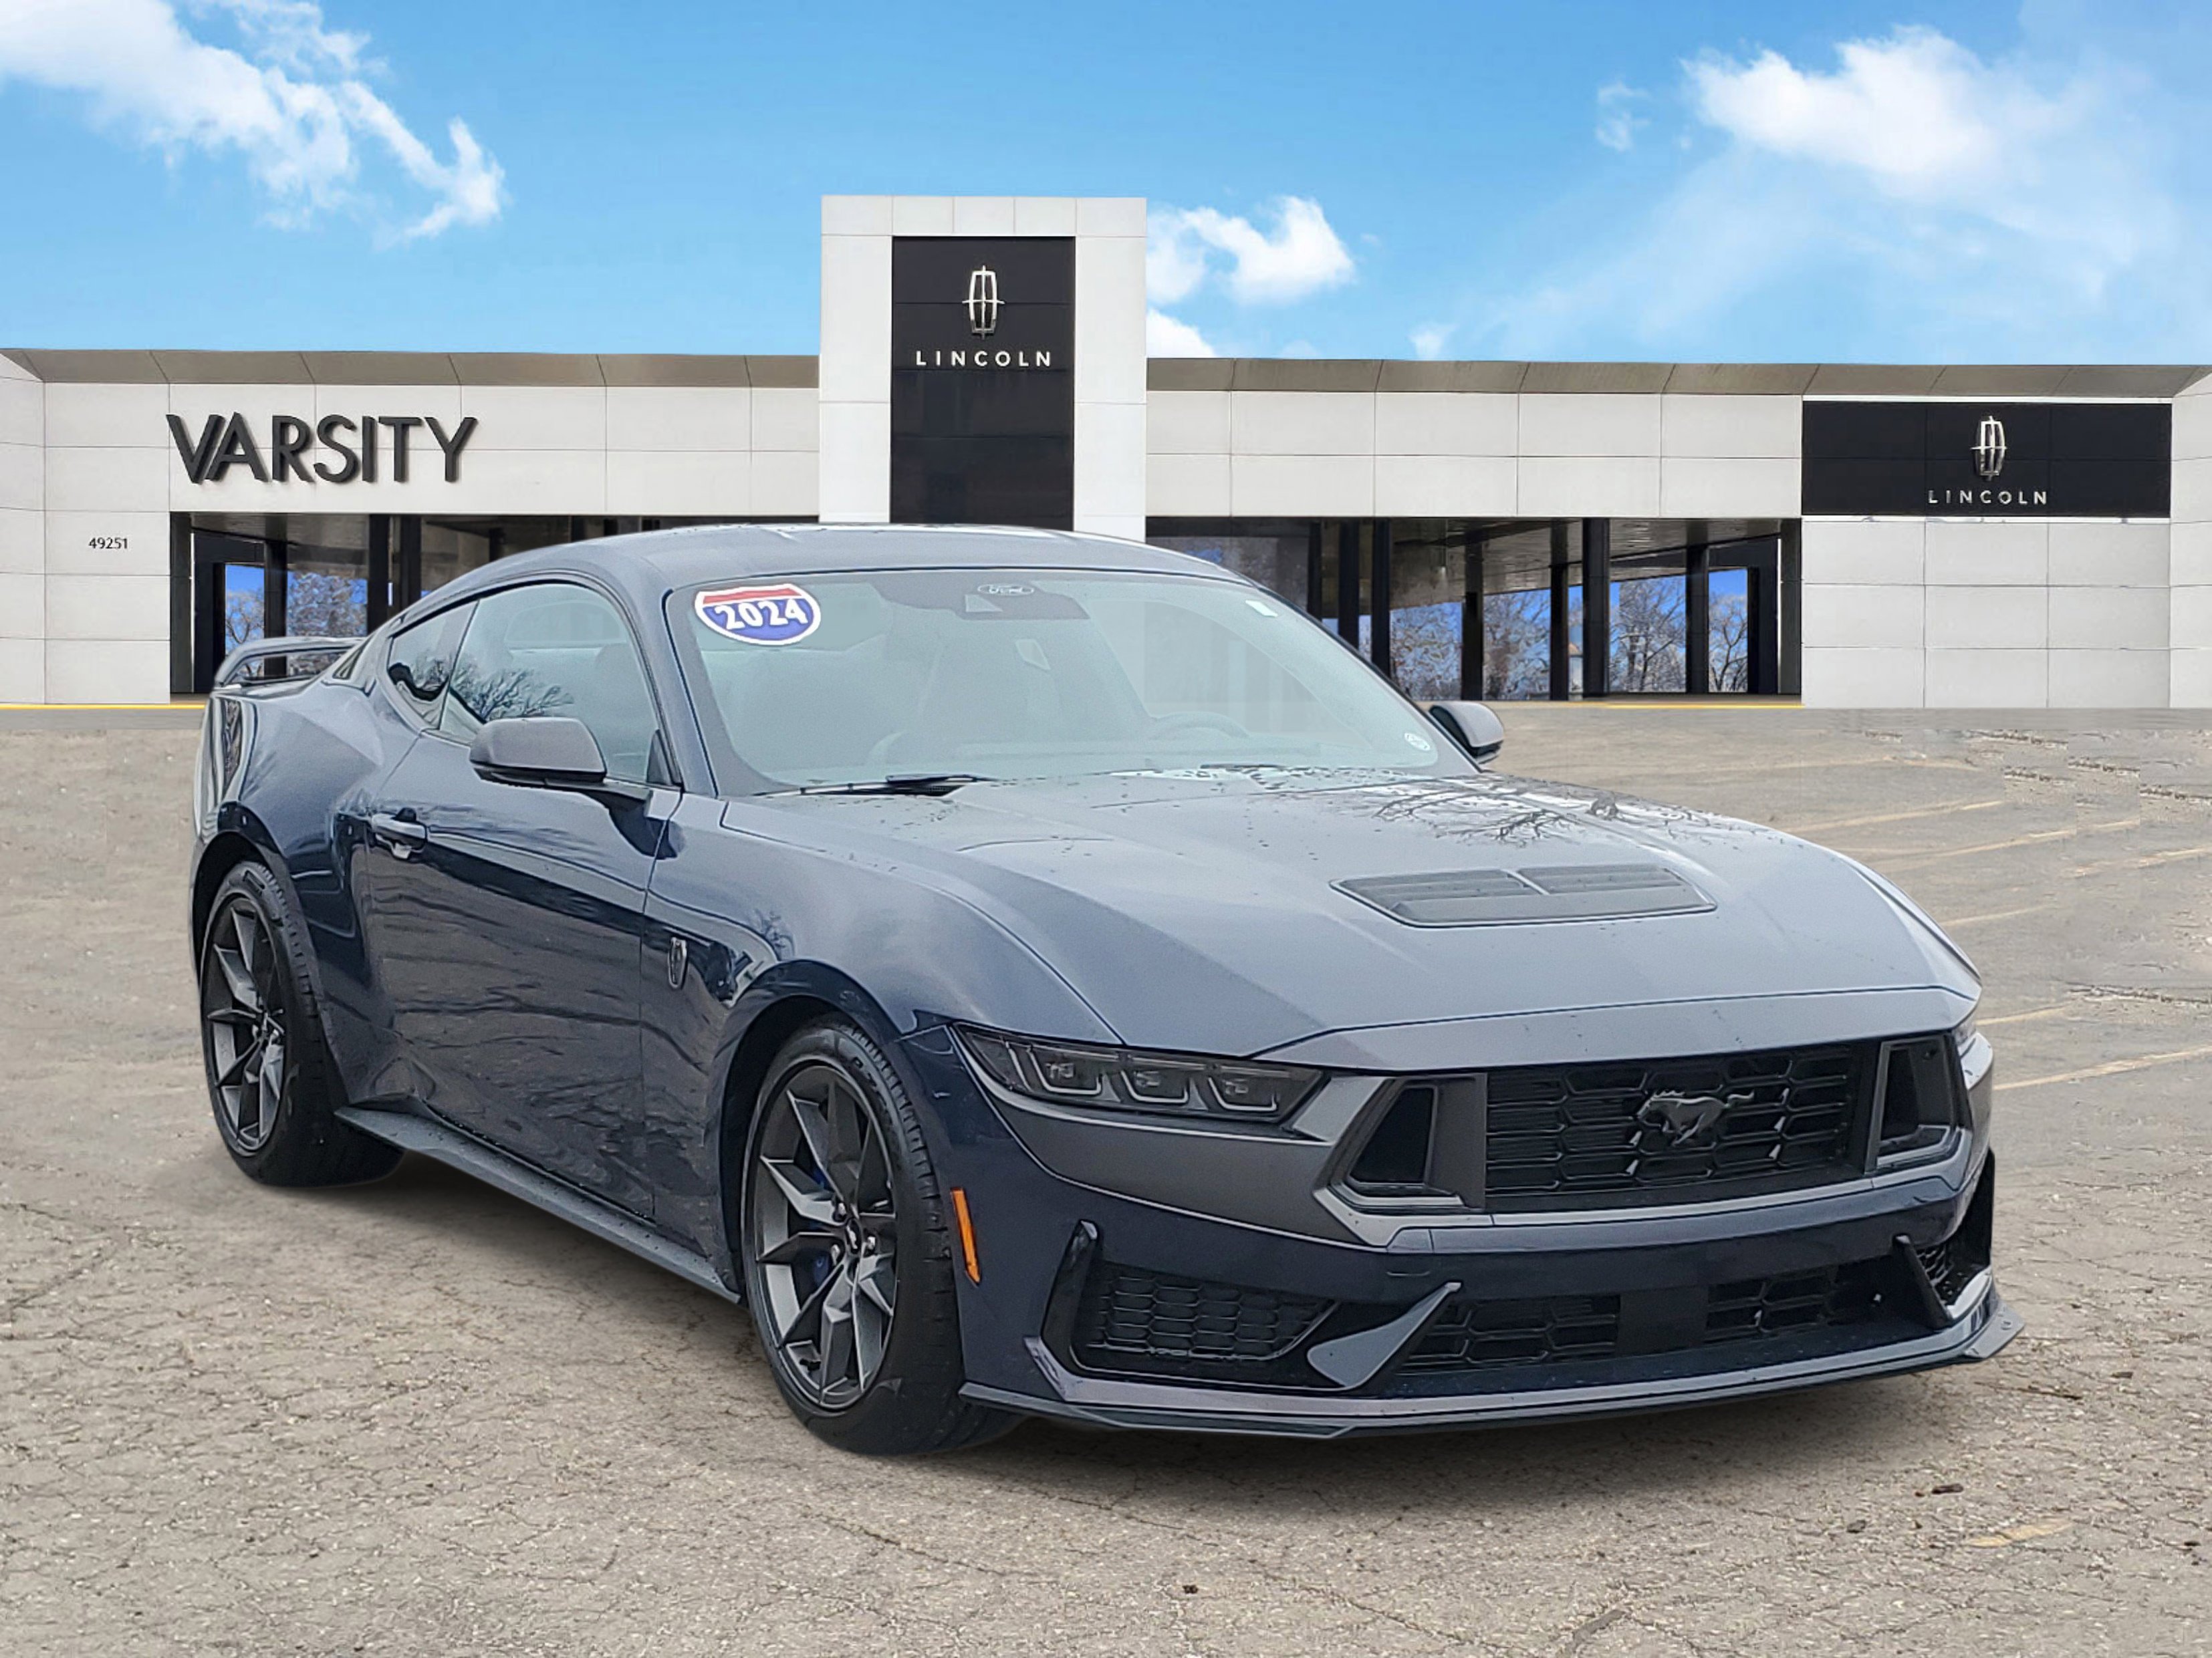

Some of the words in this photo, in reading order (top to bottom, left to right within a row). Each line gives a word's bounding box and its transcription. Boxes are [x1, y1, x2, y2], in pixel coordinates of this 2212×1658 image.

[915, 350, 1052, 368] LINCOLN
[166, 412, 479, 484] VARSITY
[1928, 490, 2048, 506] LINCOLN
[88, 537, 128, 549] 49251
[714, 599, 809, 630] 2024
